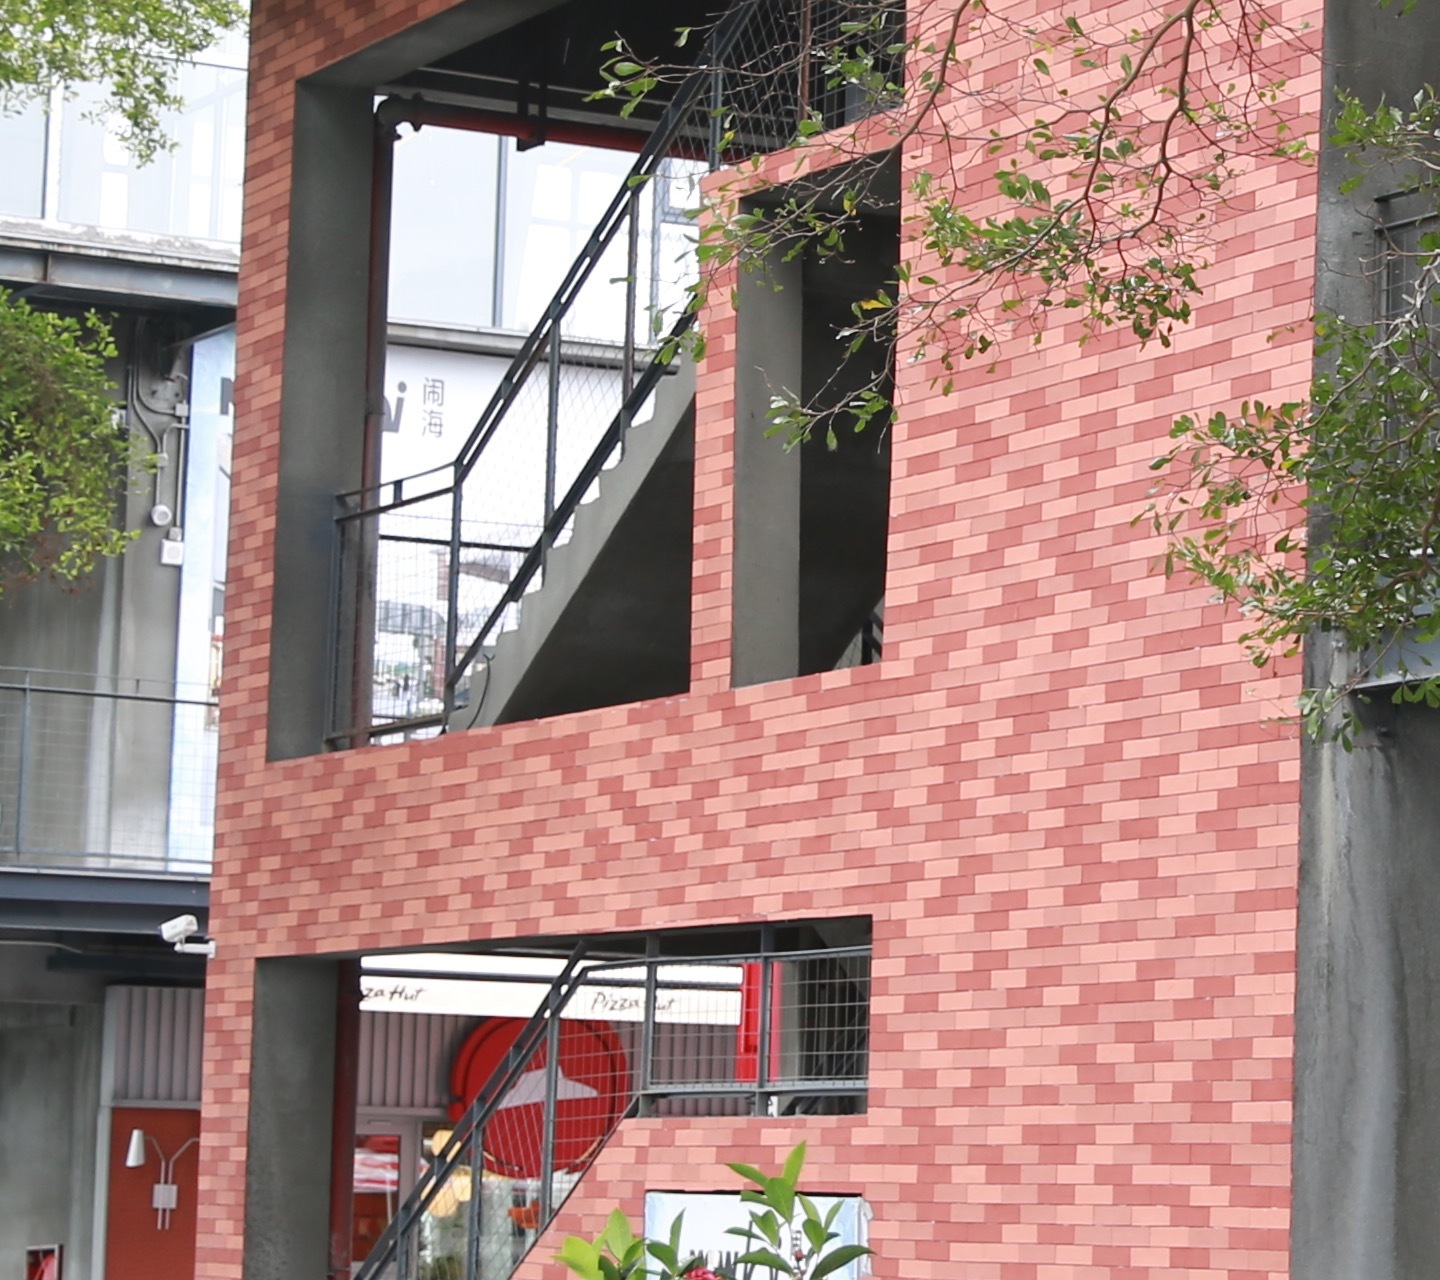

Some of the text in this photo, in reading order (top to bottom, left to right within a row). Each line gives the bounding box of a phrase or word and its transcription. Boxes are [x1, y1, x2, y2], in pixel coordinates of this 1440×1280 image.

[422, 376, 445, 438] 闹海
[388, 984, 427, 1002] Hut
[590, 991, 640, 1012] Pizza
